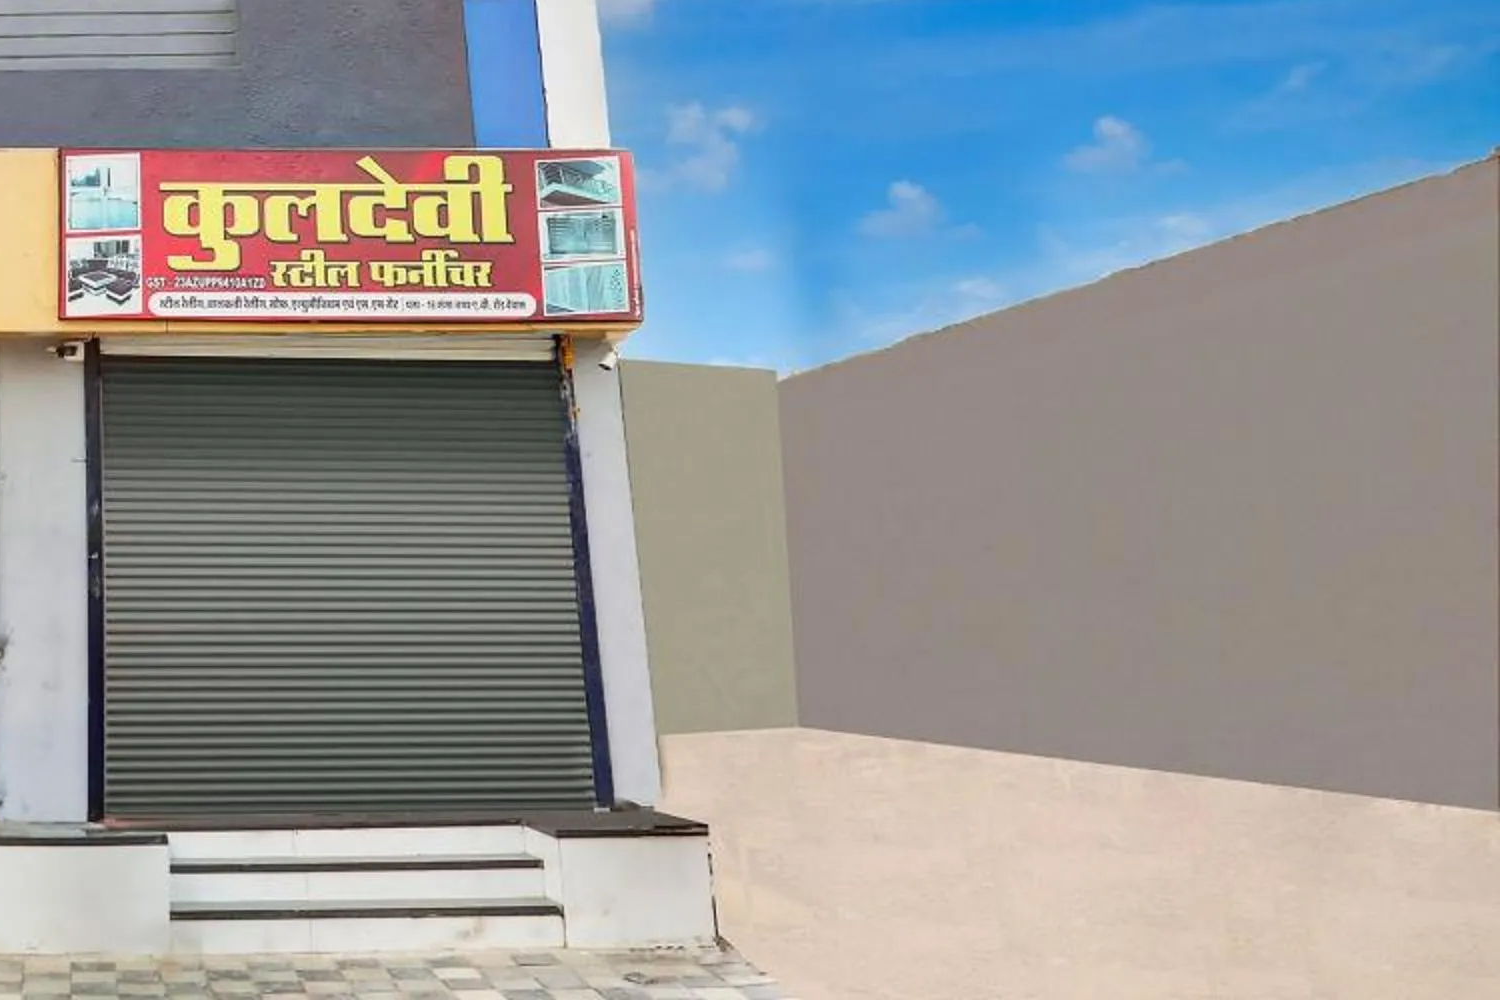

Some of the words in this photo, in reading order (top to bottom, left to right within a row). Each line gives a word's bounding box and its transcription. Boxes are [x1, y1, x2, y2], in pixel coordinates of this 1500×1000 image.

[159, 155, 514, 272] कुलदेवी
[270, 249, 360, 288] स्टील
[367, 249, 493, 288] फर्नीचर
